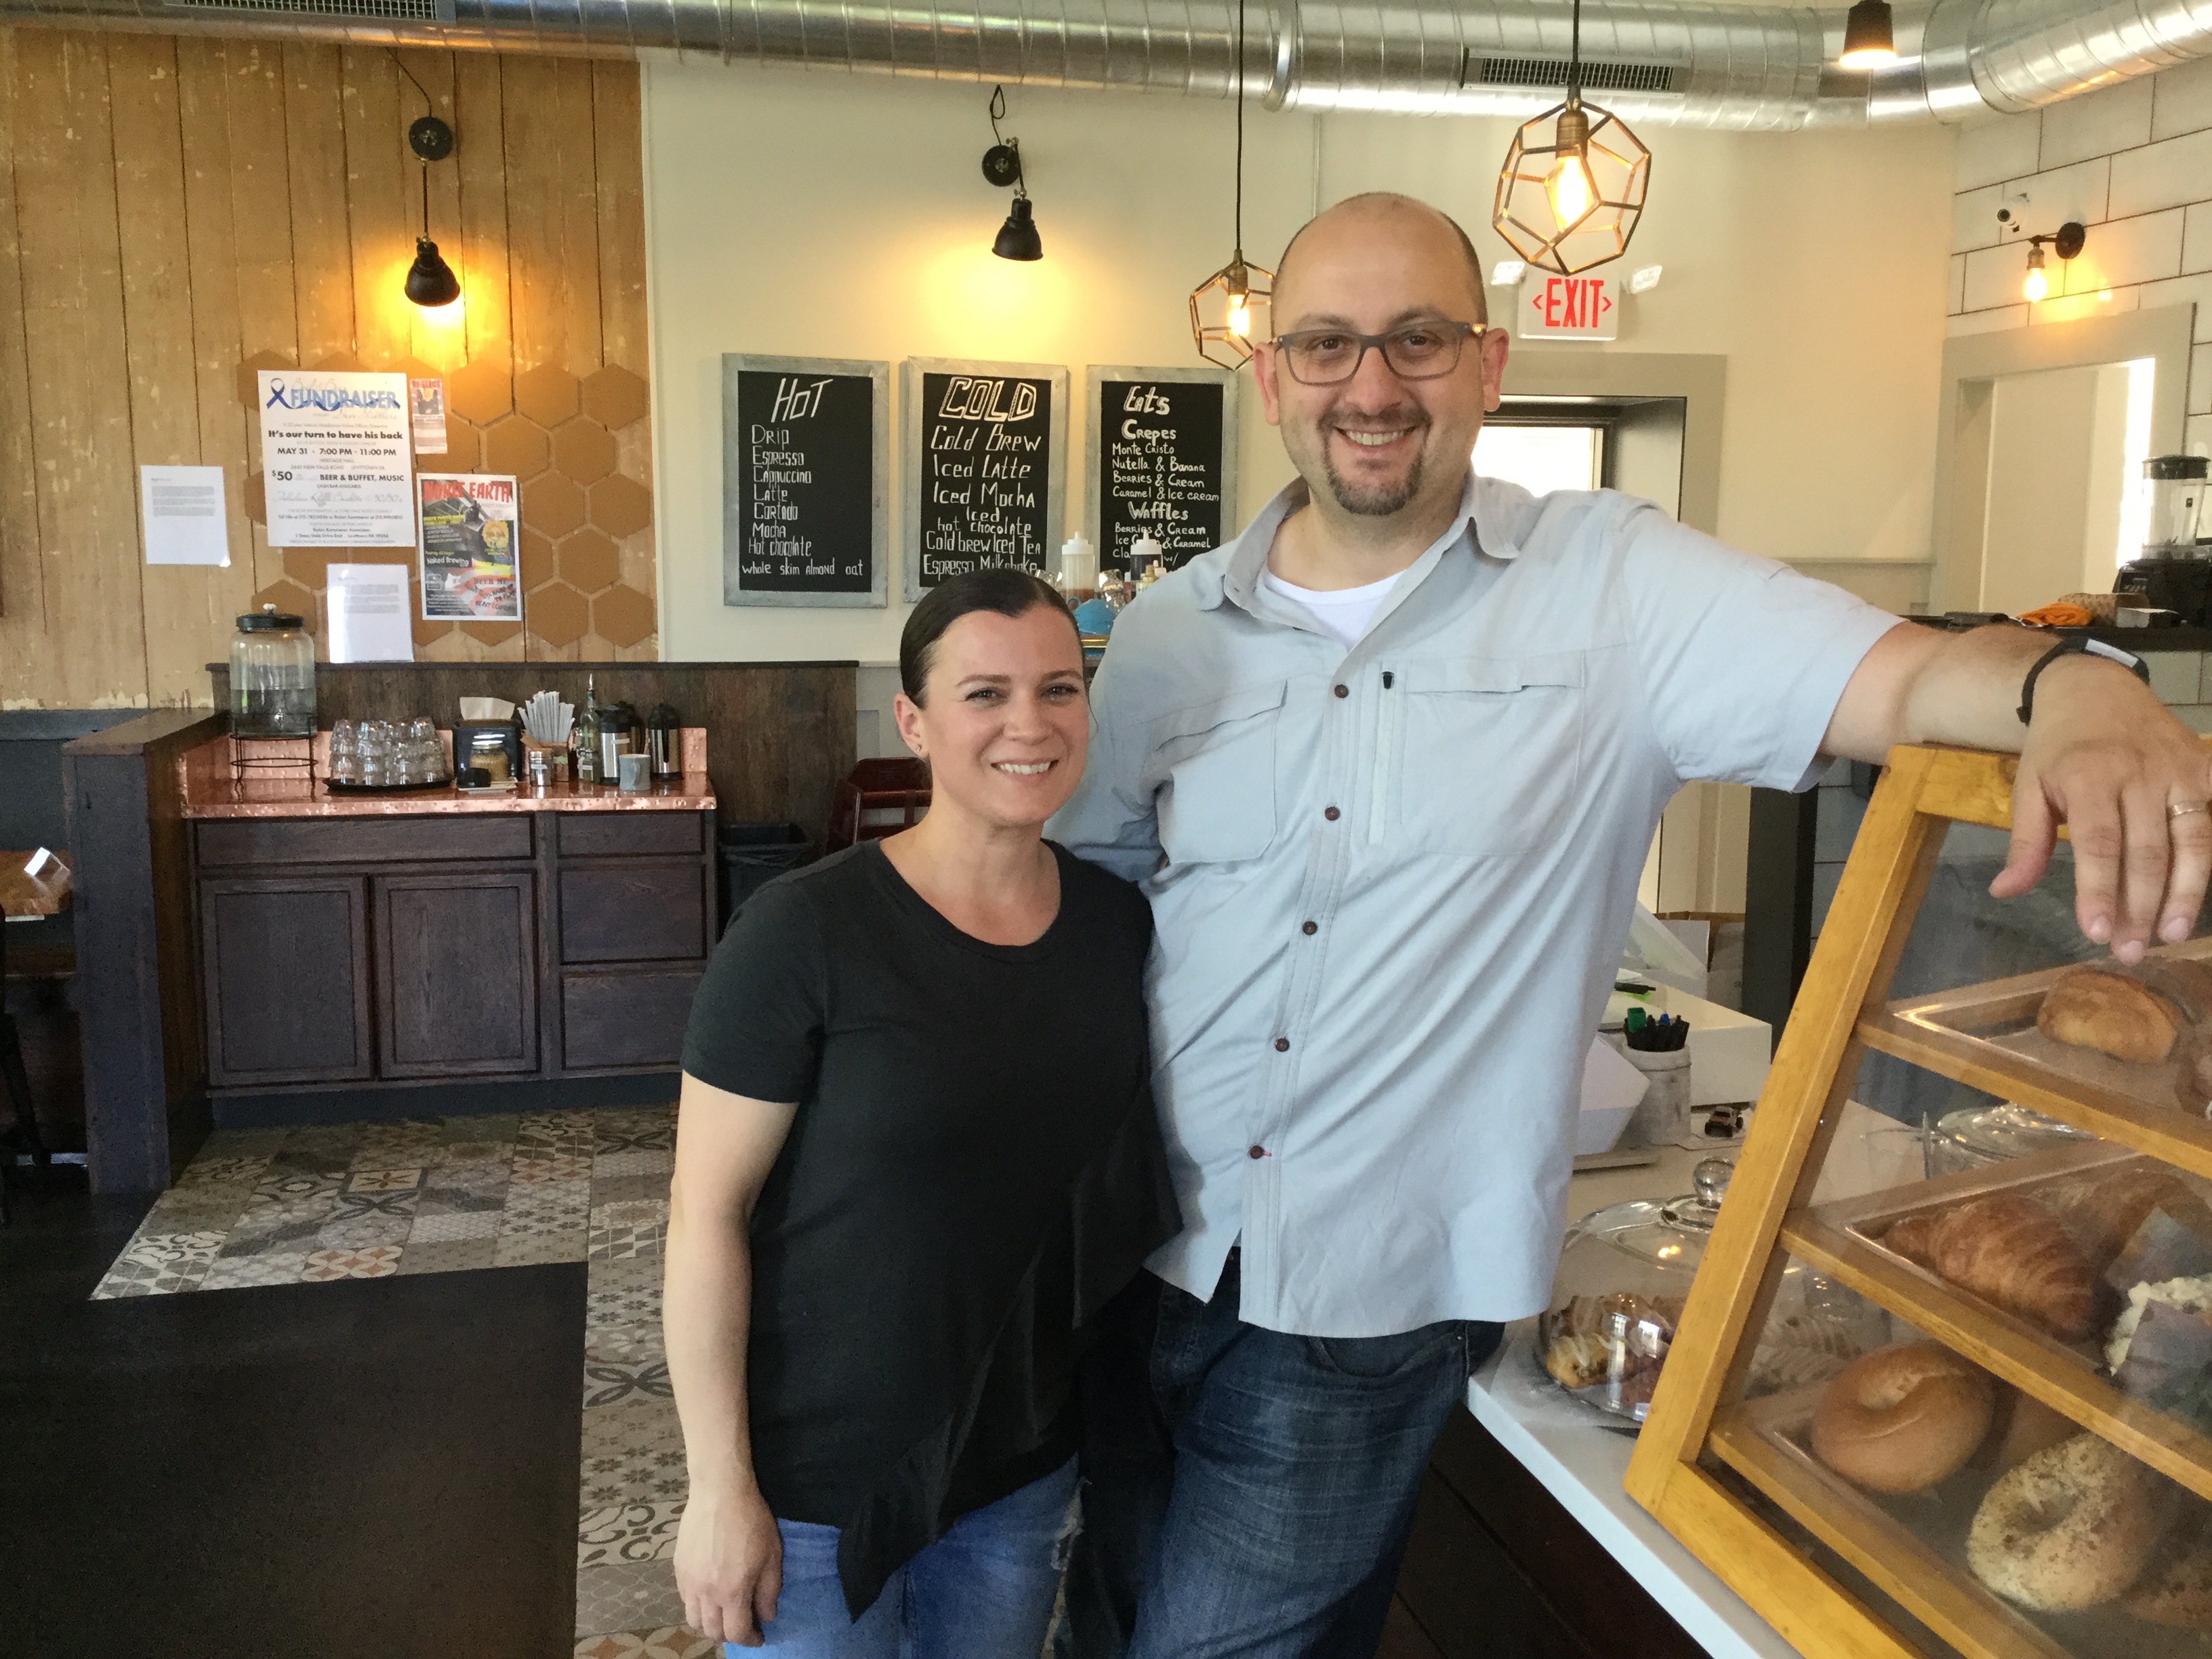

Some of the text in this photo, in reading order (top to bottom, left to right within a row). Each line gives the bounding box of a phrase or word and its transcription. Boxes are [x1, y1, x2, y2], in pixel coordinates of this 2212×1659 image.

[1545, 278, 1604, 328] EXIT
[291, 389, 396, 409] FUNDRAISER
[771, 377, 834, 423] HOT
[938, 376, 1037, 422] COLD
[1123, 385, 1170, 415] Eats
[339, 430, 362, 439] have
[365, 430, 378, 439] his
[381, 431, 403, 439] back
[752, 424, 790, 450] Drip
[930, 424, 1042, 451] Cold Brew
[1121, 418, 1176, 446] Crepes
[753, 445, 804, 470] Espresso
[1112, 442, 1174, 456] Monte Cristo
[934, 453, 1031, 479] Iced Latte
[1112, 456, 1206, 472] Nutella & Banana
[272, 470, 293, 481] $50
[753, 466, 812, 489] Cappuccino
[1113, 472, 1204, 489] Berries & Cream
[469, 482, 511, 503] EARTH
[754, 484, 788, 502] Latte
[933, 481, 1036, 508] Iced Mocha
[1112, 486, 1219, 501] Caramel & Ice cream
[754, 501, 798, 520] Cortado
[966, 506, 1000, 523] Iced
[1128, 501, 1189, 520] Waffles
[752, 519, 786, 538] Mocha
[937, 516, 1031, 536] hot chocolate
[1115, 522, 1206, 537] Berries & Cream
[748, 535, 812, 557] Hot chocolate
[926, 531, 1041, 555] Cold brew Iced Tea
[1115, 534, 1129, 545] Ice
[1162, 535, 1172, 550] &
[1173, 535, 1211, 548] Caramel
[742, 557, 863, 576] whole skim almond oat
[923, 554, 974, 581] Espresso
